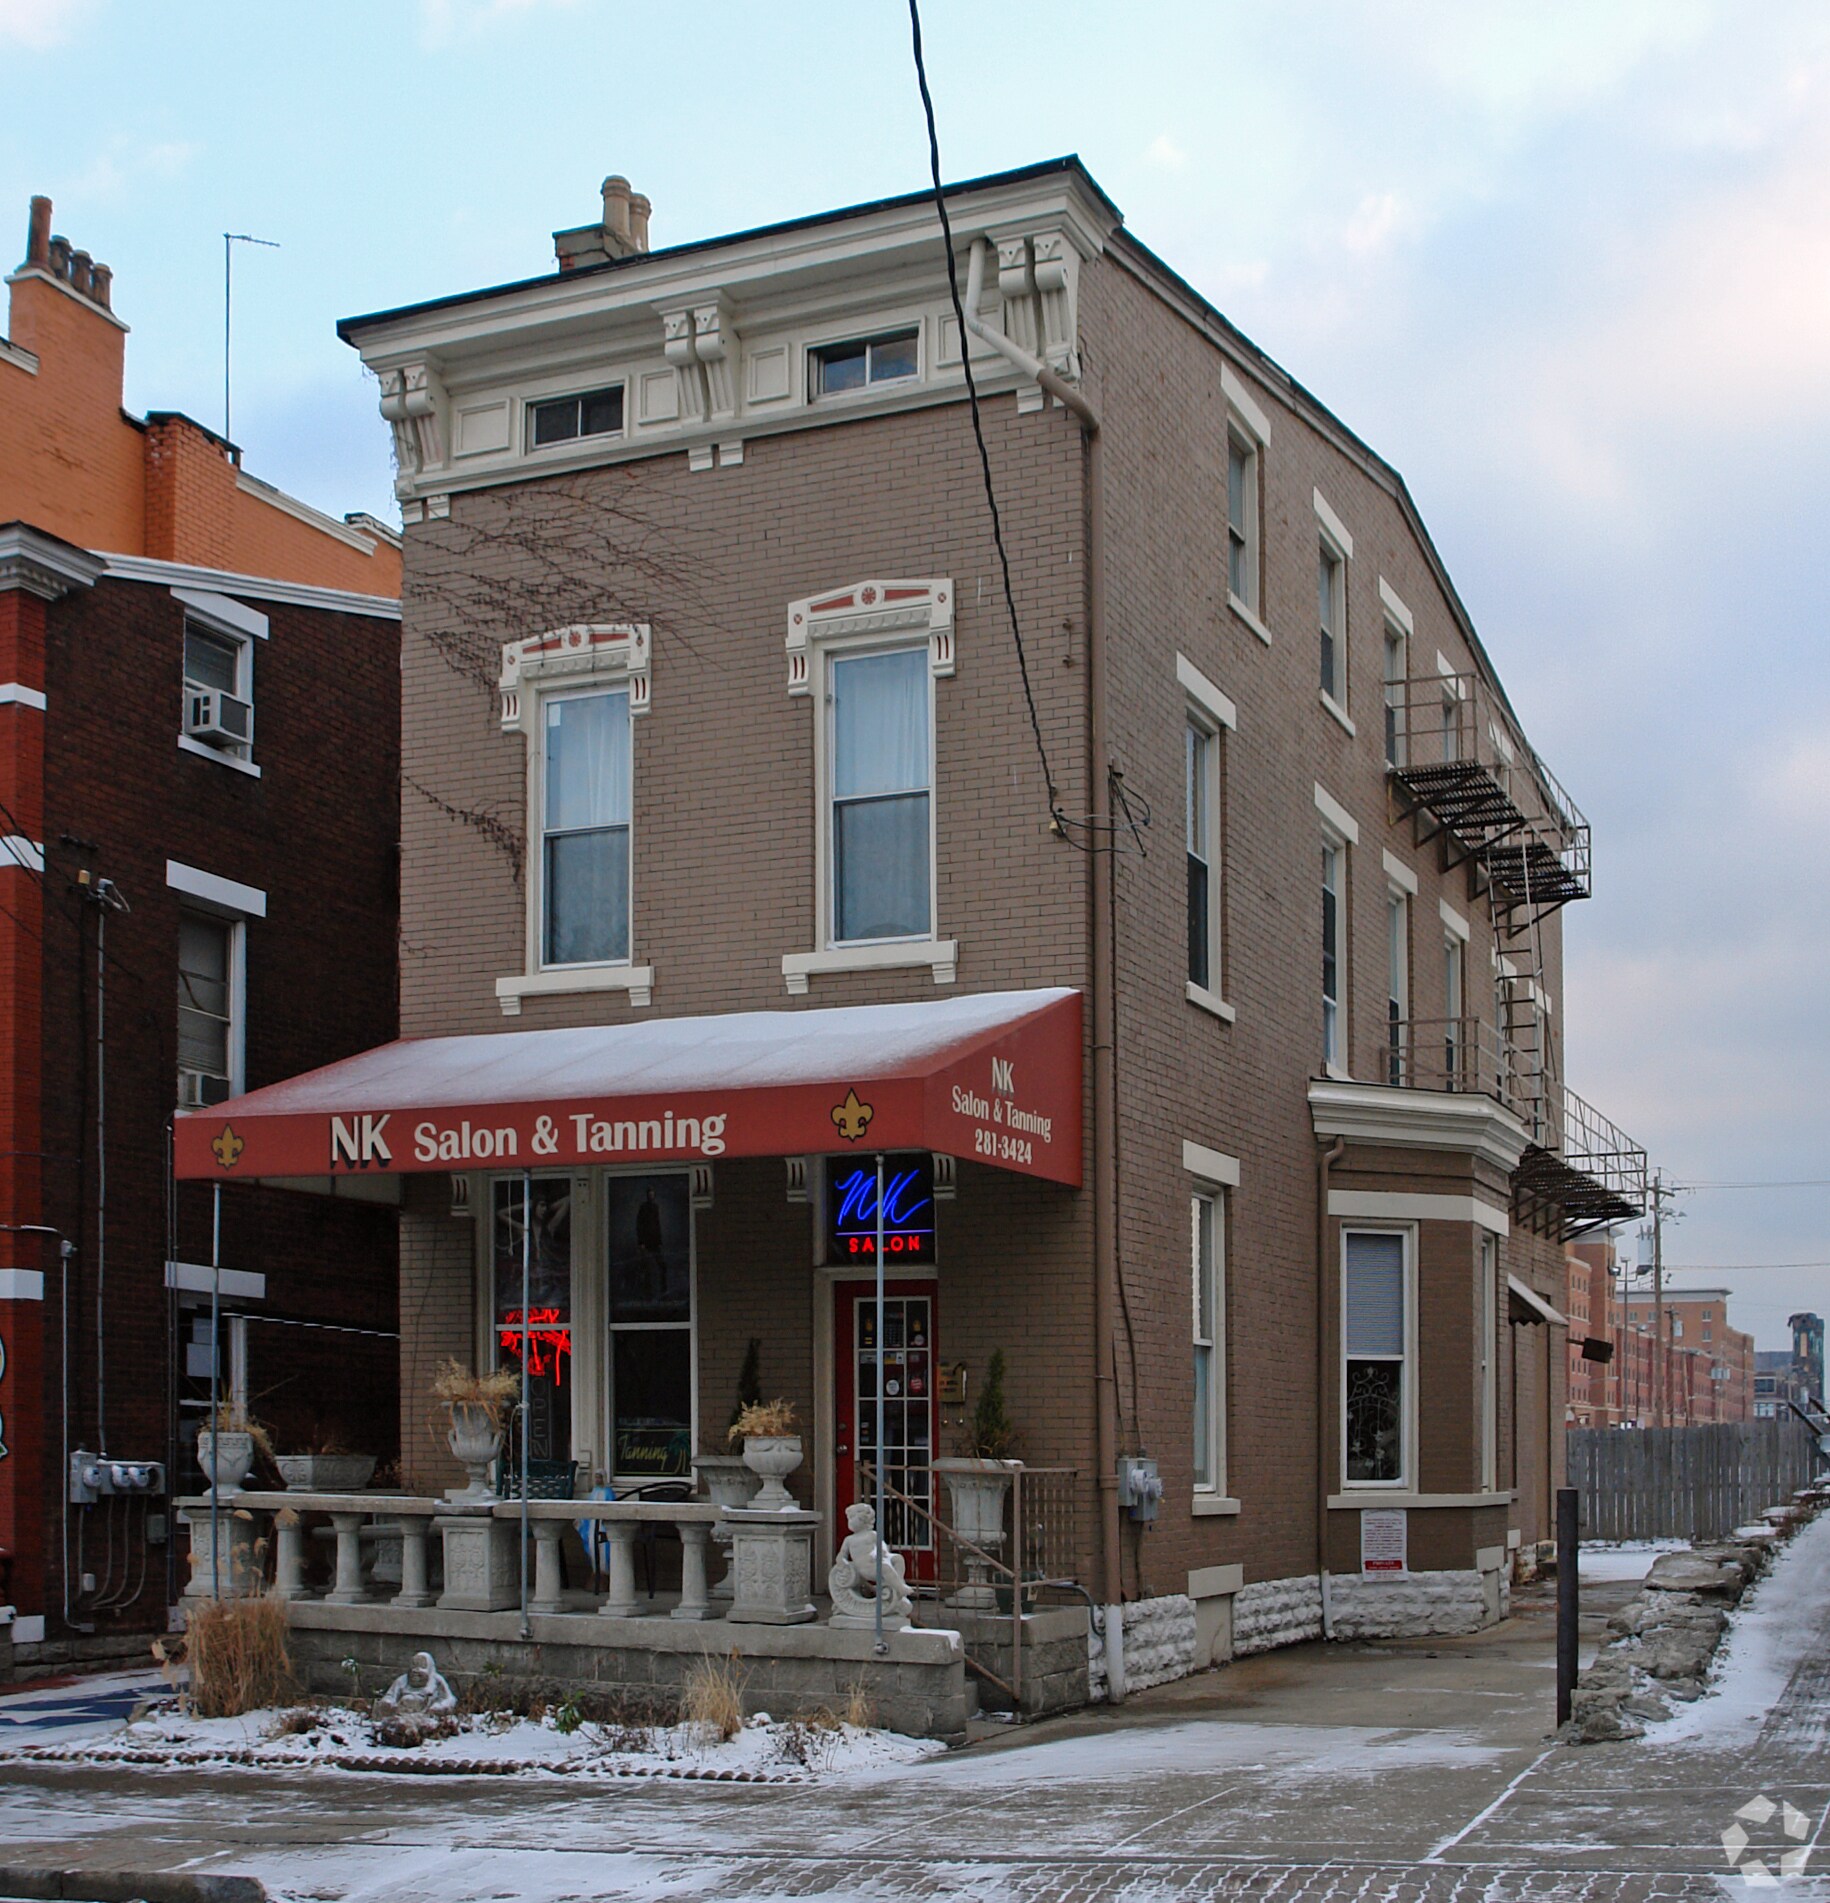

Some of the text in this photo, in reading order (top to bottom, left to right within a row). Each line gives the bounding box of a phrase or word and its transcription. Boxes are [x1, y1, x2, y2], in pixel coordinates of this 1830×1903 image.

[992, 1056, 1015, 1094] NK
[952, 1085, 1052, 1143] Salon & Tanning
[331, 1110, 728, 1164] NK Salon & Tanning
[975, 1128, 1032, 1165] 281-3424
[617, 1433, 669, 1471] Tanning
